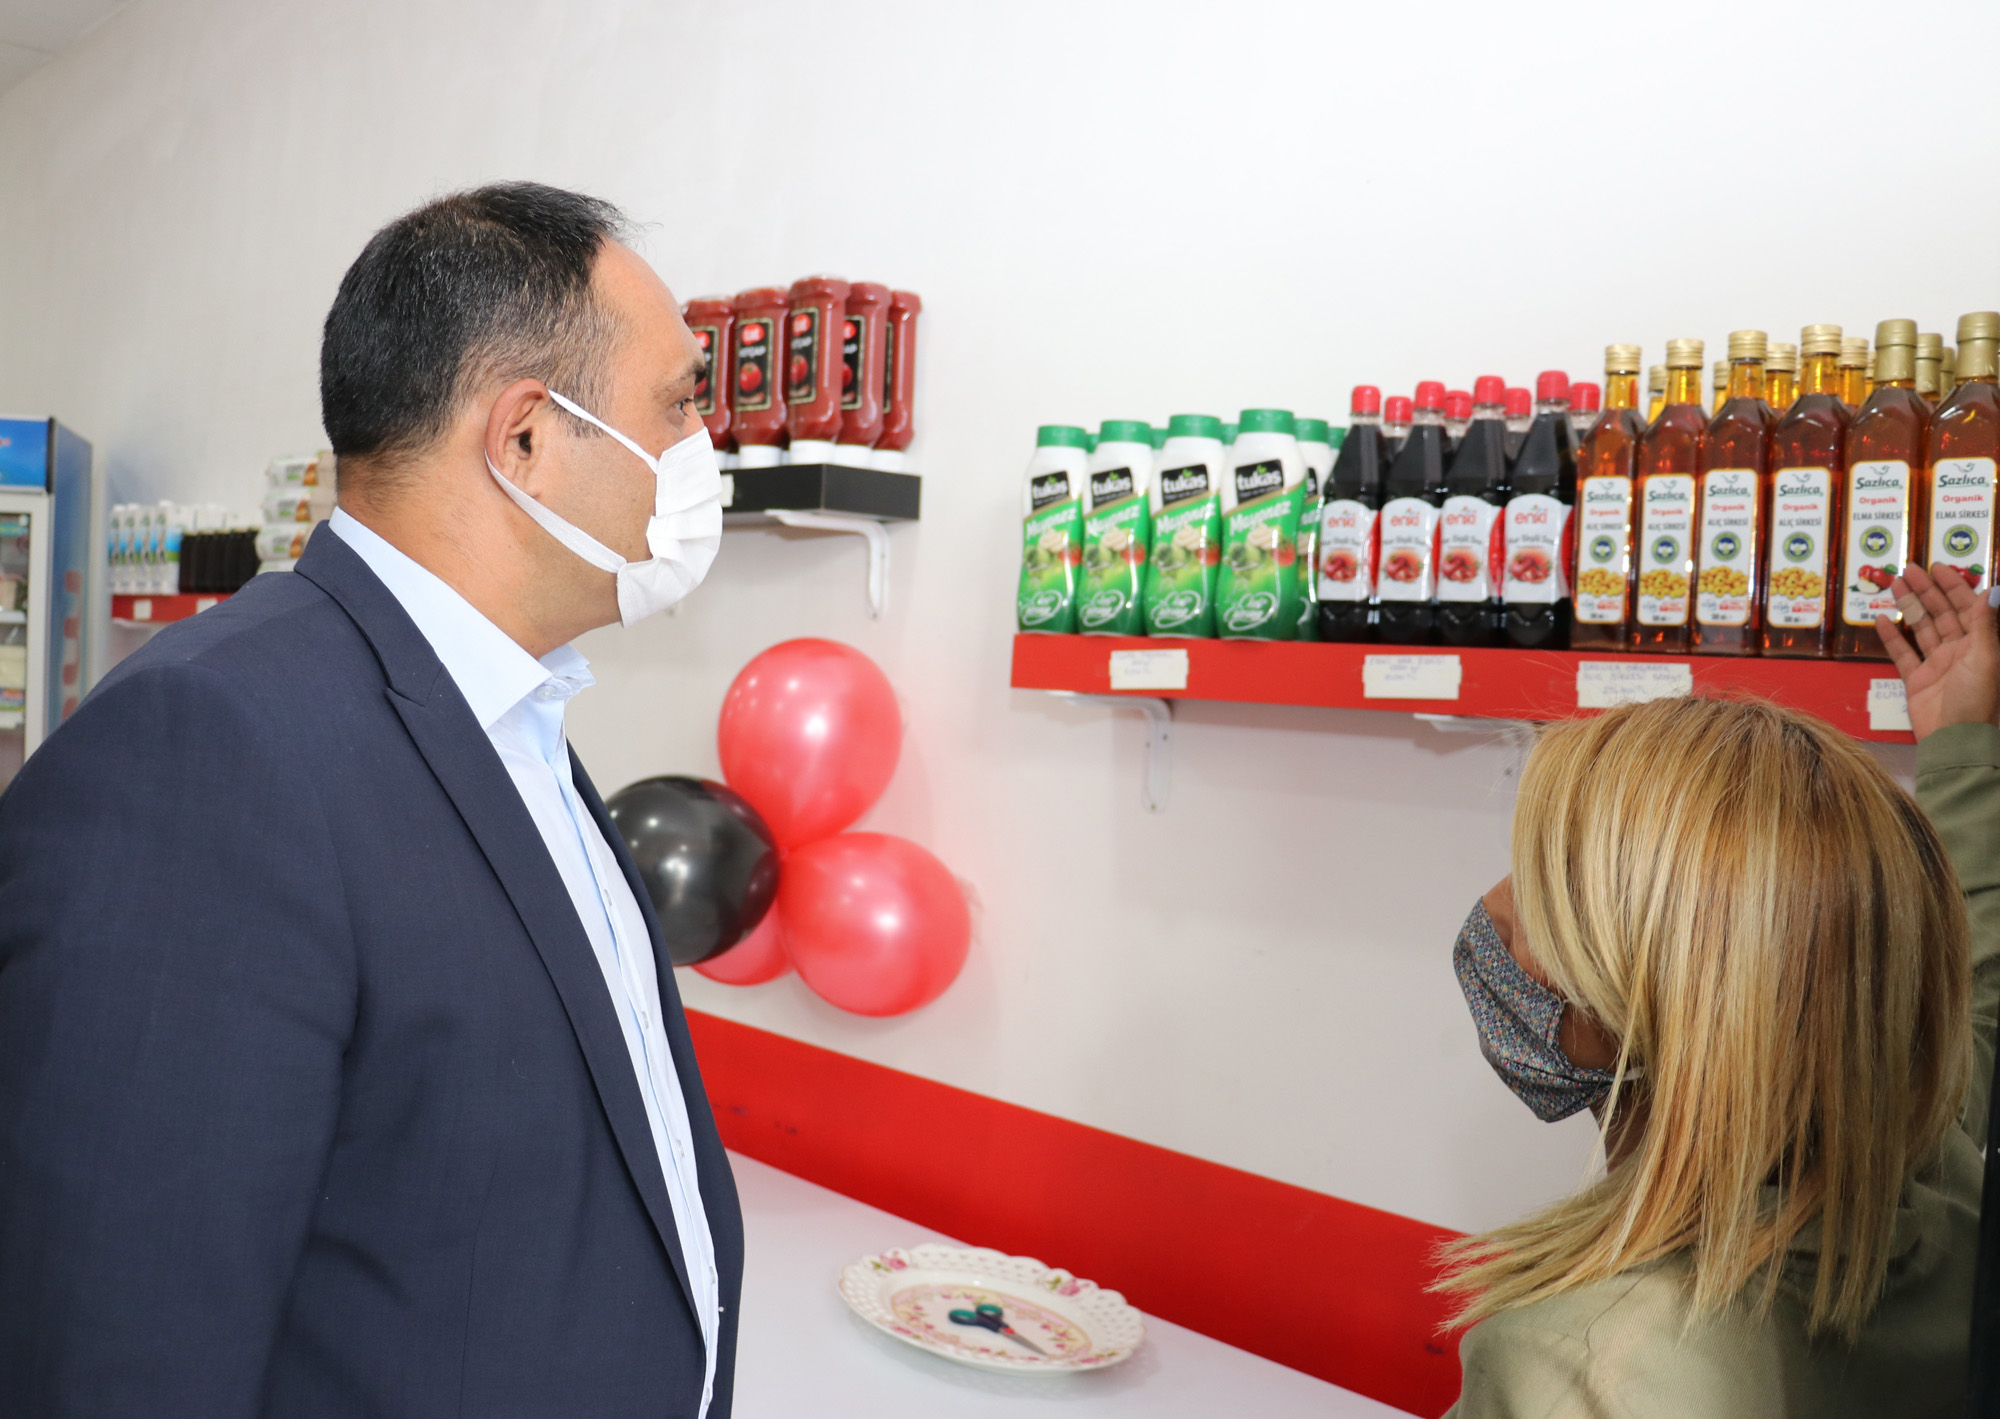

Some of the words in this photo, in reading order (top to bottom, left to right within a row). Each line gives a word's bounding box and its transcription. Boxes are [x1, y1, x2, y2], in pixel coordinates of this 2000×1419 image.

[1859, 497, 1898, 505] Organik
[1942, 494, 1983, 504] Organik
[1853, 511, 1872, 520] ELMA
[1936, 510, 1957, 519] ELMA
[1958, 509, 1989, 519] SİRKESİ
